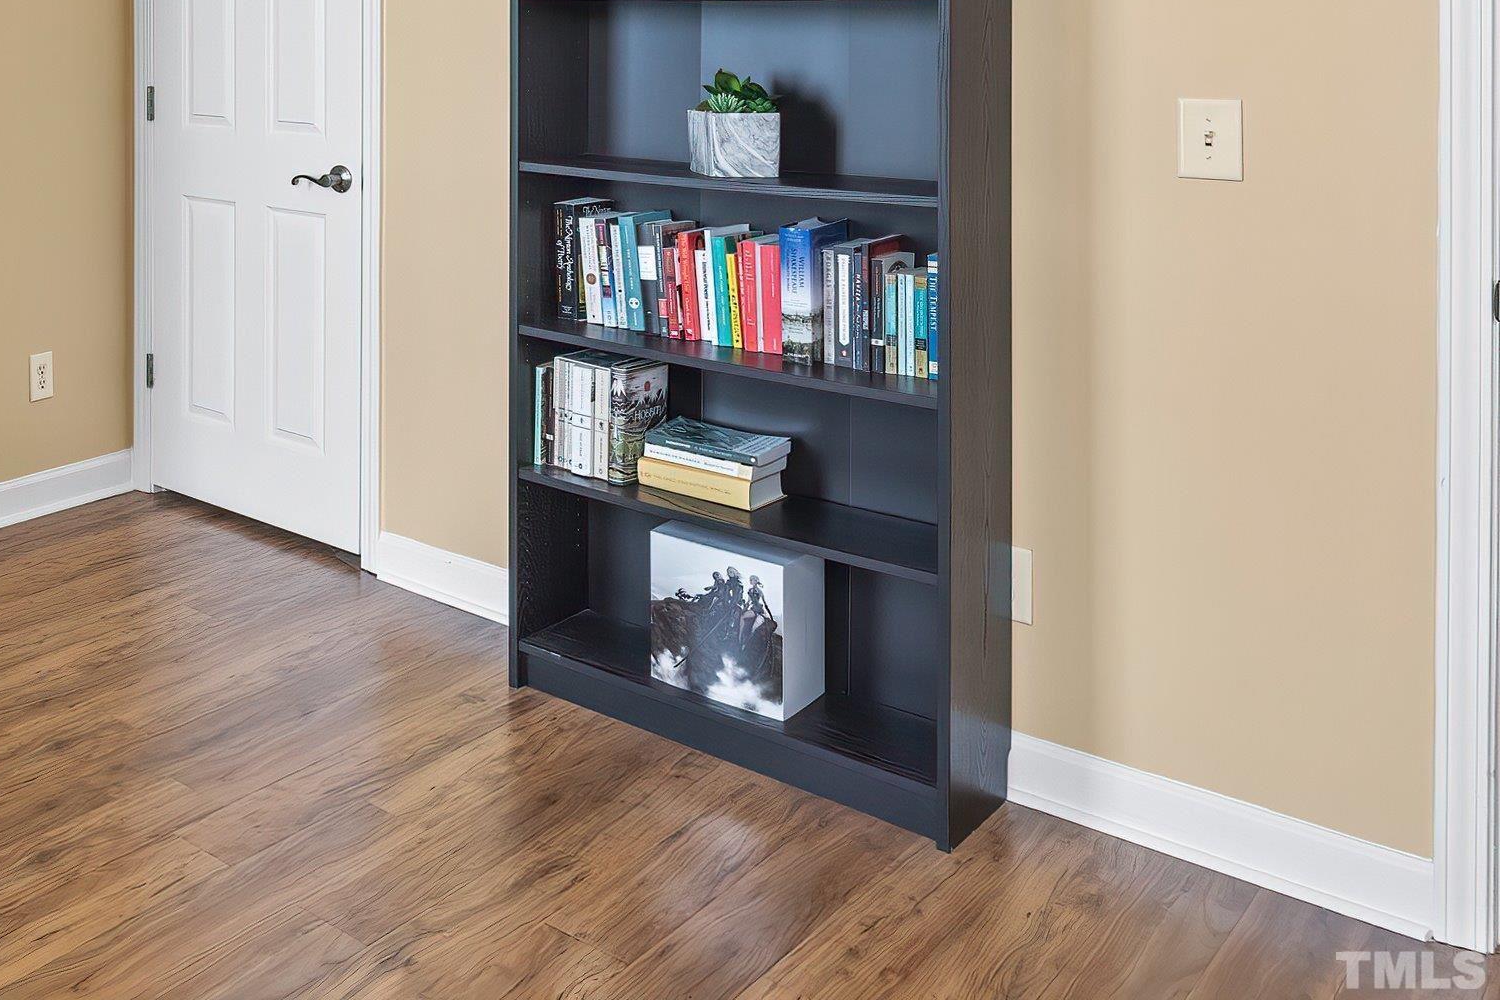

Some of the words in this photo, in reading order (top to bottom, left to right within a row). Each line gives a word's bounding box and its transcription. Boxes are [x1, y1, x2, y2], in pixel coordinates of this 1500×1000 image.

[565, 216, 573, 229] The
[556, 240, 565, 248] of
[564, 229, 573, 254] Norton
[557, 250, 565, 270] Poetry
[565, 255, 574, 291] Anthology
[929, 276, 938, 291] THE
[930, 296, 938, 331] TEMPEST
